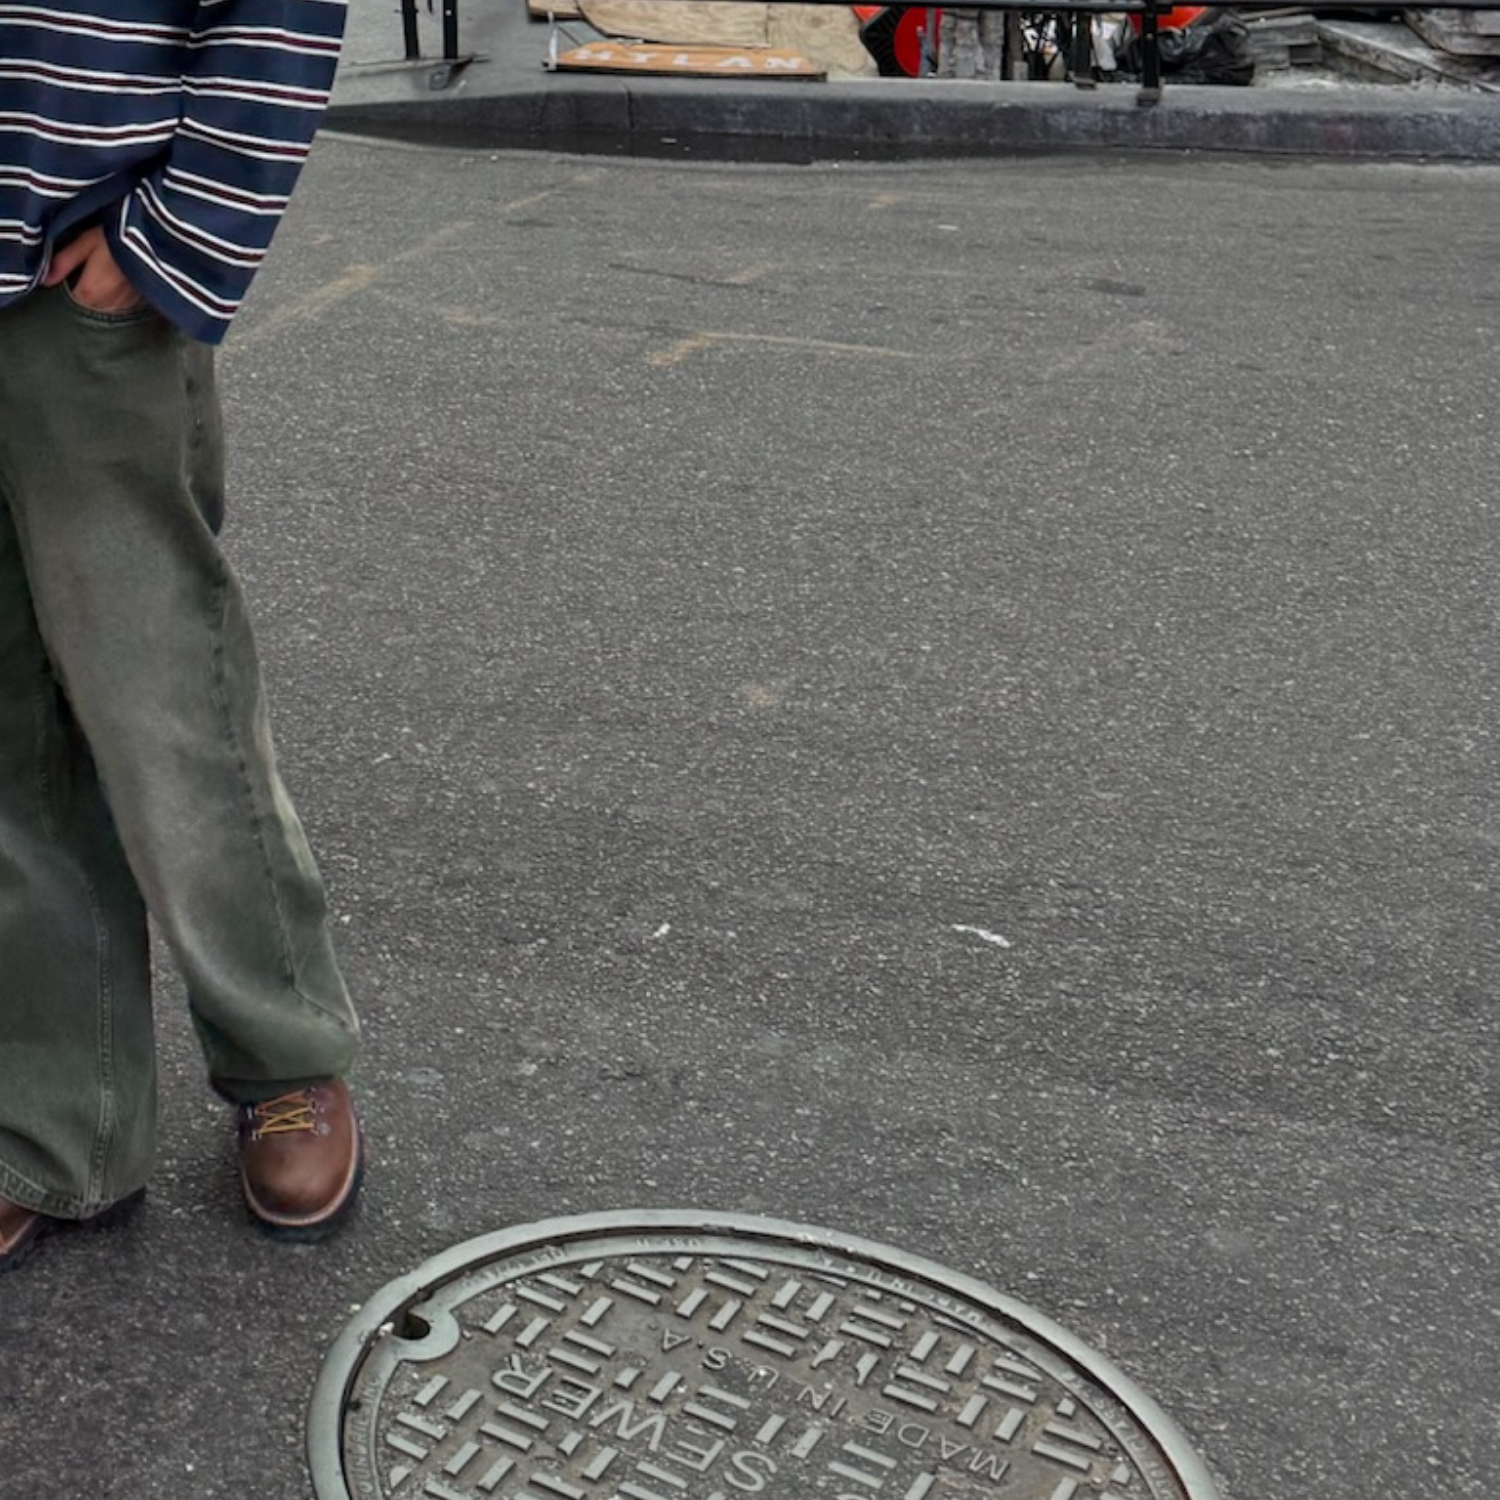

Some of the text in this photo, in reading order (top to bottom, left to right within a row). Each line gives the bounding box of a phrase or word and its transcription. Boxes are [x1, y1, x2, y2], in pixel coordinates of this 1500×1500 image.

[492, 1352, 779, 1492] SEWER
[799, 1383, 848, 1419] IN
[867, 1407, 1009, 1481] MADE
